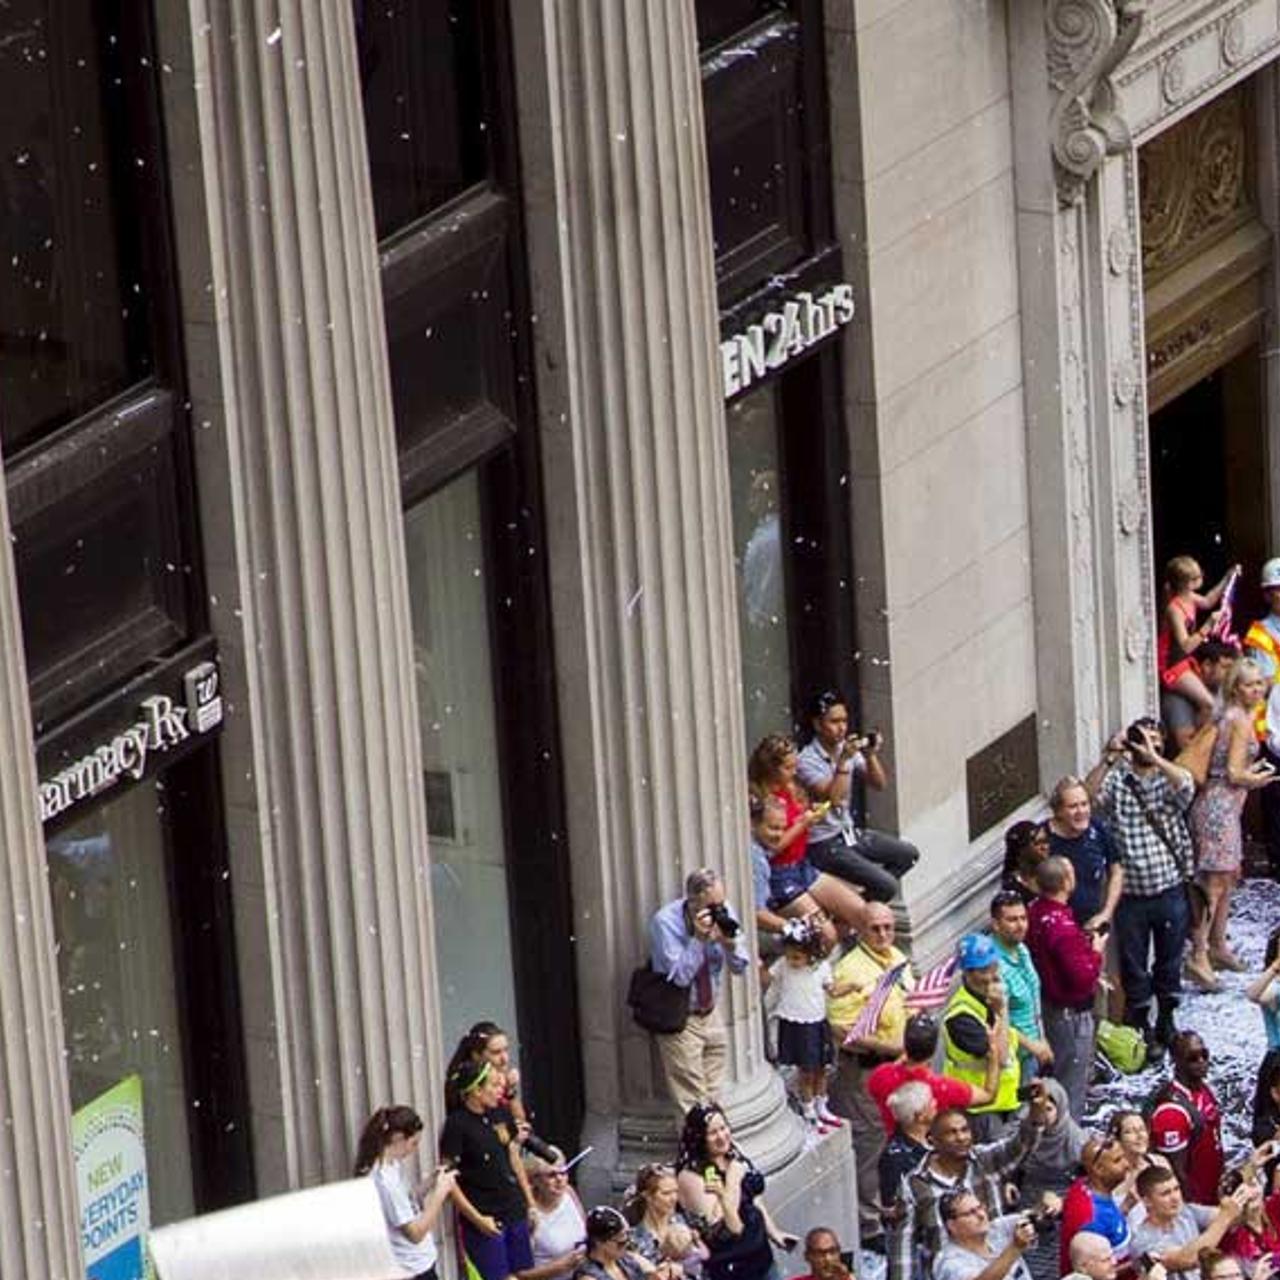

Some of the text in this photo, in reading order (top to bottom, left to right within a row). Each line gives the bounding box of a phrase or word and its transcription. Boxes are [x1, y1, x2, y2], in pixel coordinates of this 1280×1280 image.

[719, 325, 767, 398] EN
[38, 720, 150, 822] armacy
[87, 1152, 123, 1193] NEW
